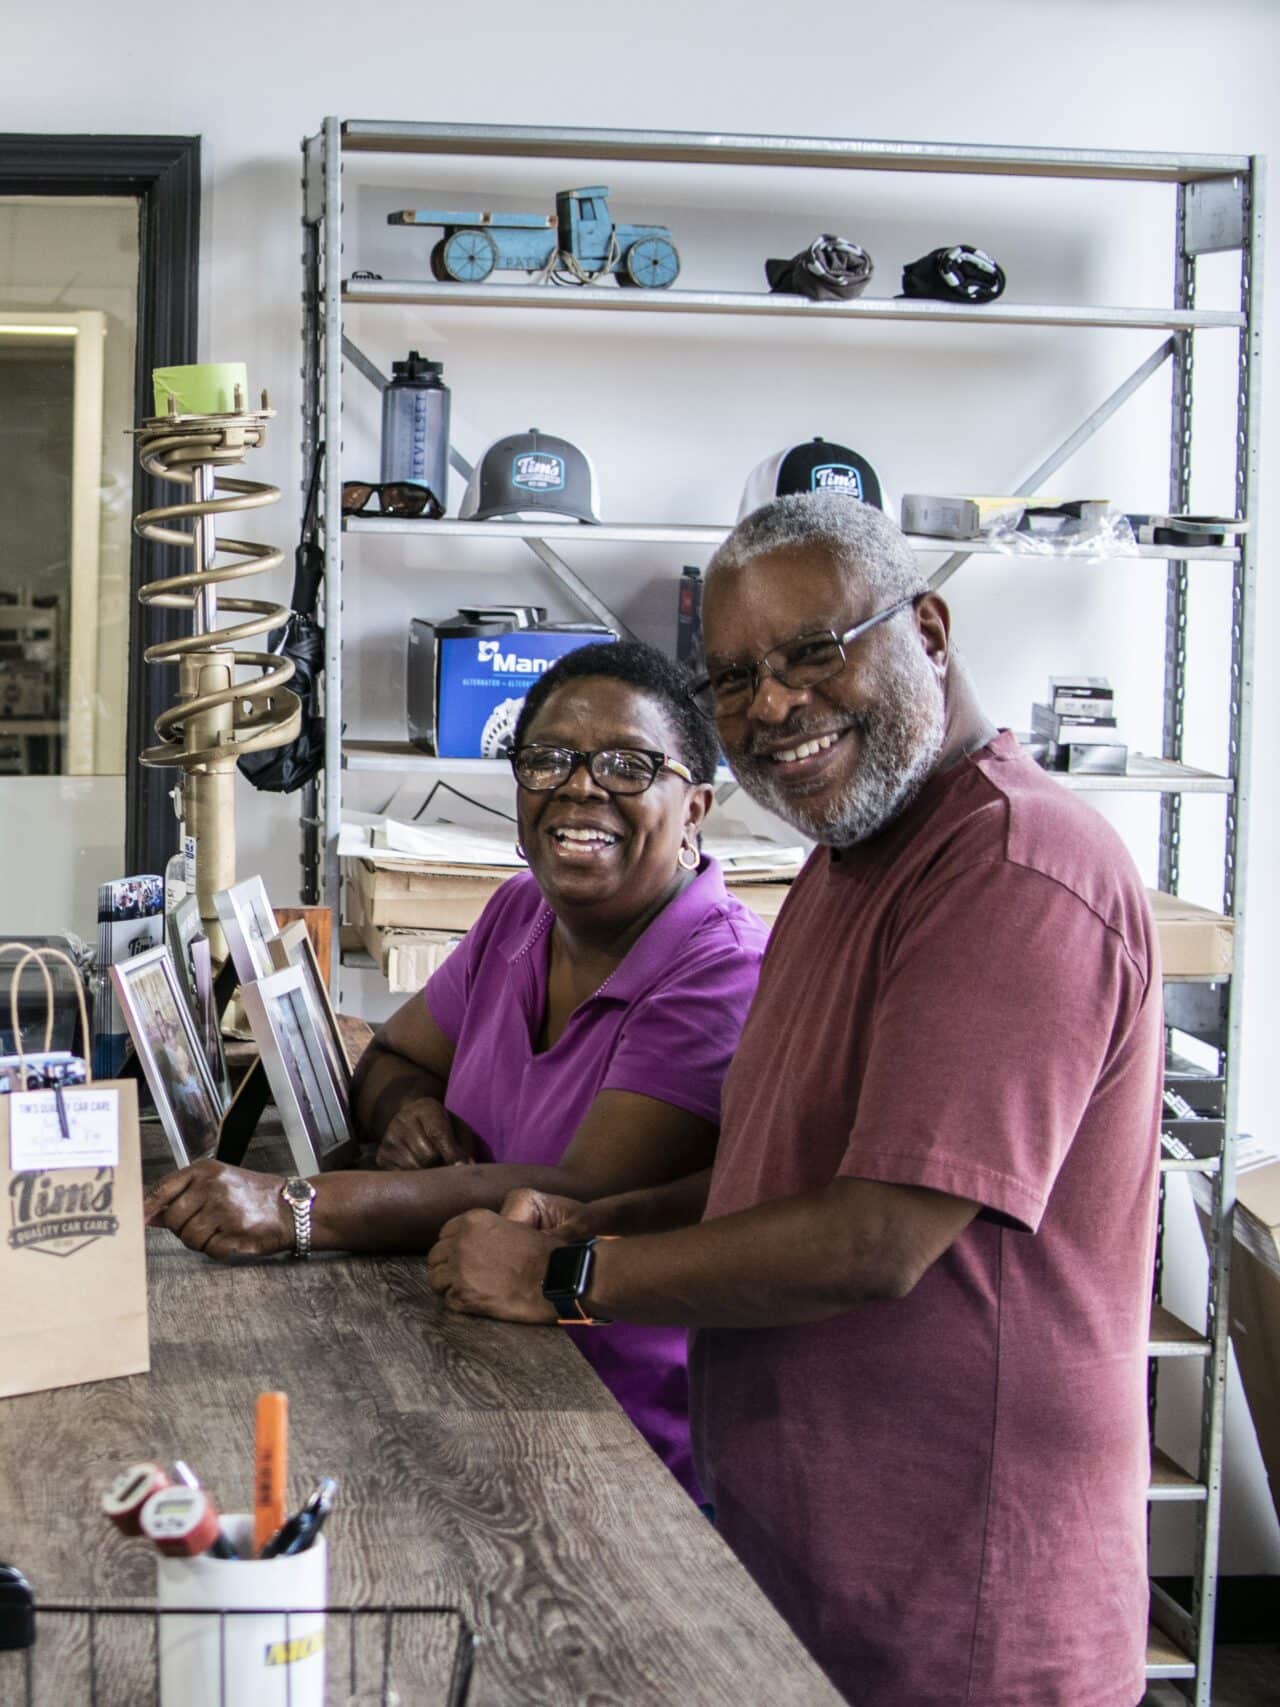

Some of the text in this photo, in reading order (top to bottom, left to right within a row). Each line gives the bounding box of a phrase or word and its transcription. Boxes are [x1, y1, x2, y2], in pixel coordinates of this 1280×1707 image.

[517, 456, 560, 476] Tim's
[816, 468, 857, 488] Tim's
[507, 679, 535, 689] ALTERN
[128, 935, 155, 956] Tim
[73, 1101, 89, 1112] CAR
[90, 1101, 110, 1112] CARE
[8, 1166, 113, 1222] Tim's
[16, 1224, 60, 1245] QUALITY
[61, 1221, 81, 1233] CAR
[82, 1220, 110, 1233] CARE
